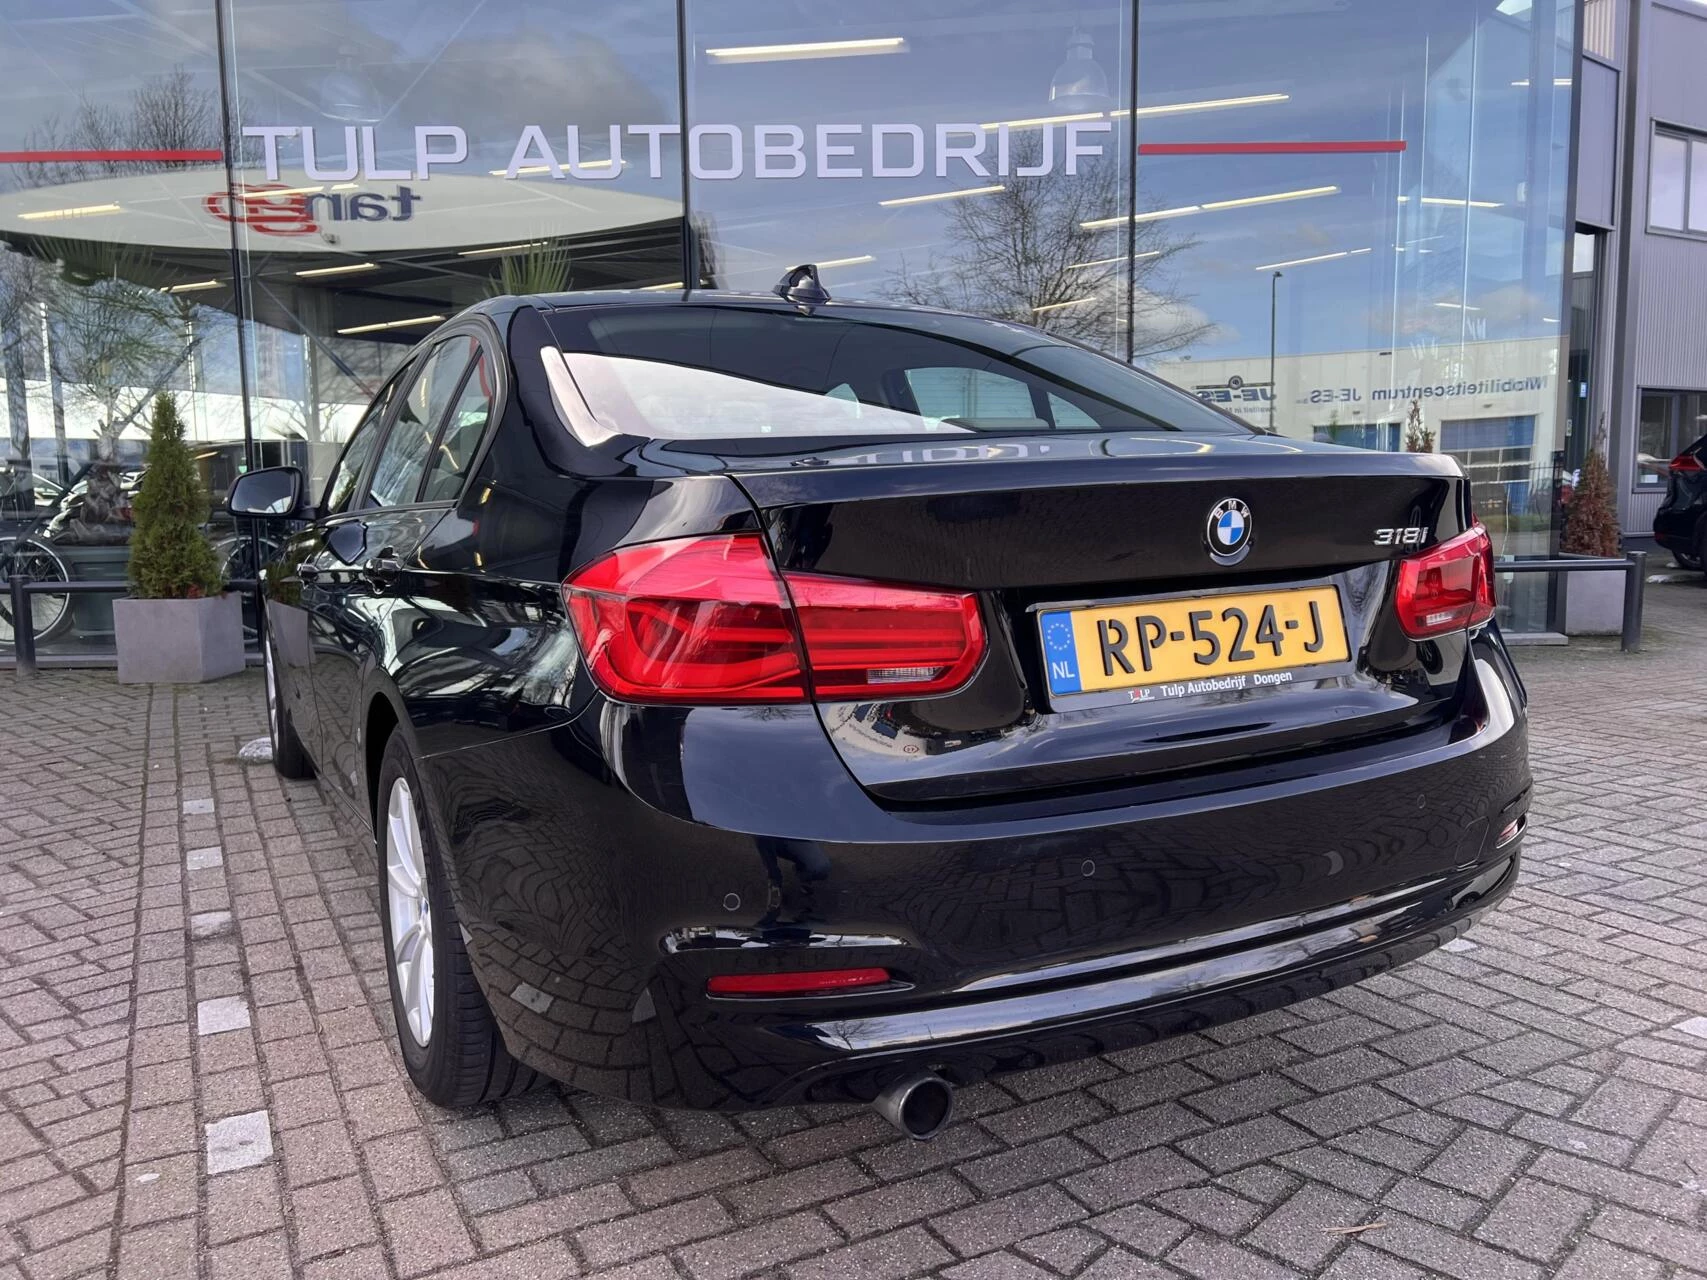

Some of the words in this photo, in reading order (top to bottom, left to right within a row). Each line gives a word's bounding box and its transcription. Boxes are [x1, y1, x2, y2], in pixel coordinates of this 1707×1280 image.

[242, 126, 468, 181] TULP
[504, 122, 1111, 180] AUTOBEDRIJF
[1213, 500, 1250, 519] BMW
[1373, 527, 1428, 546] 318i
[1096, 601, 1324, 677] RP-524-J
[1052, 661, 1075, 680] NL
[1160, 684, 1185, 697] Tulp
[1187, 676, 1246, 693] Autobedrijf
[1254, 671, 1293, 686] Dongen
